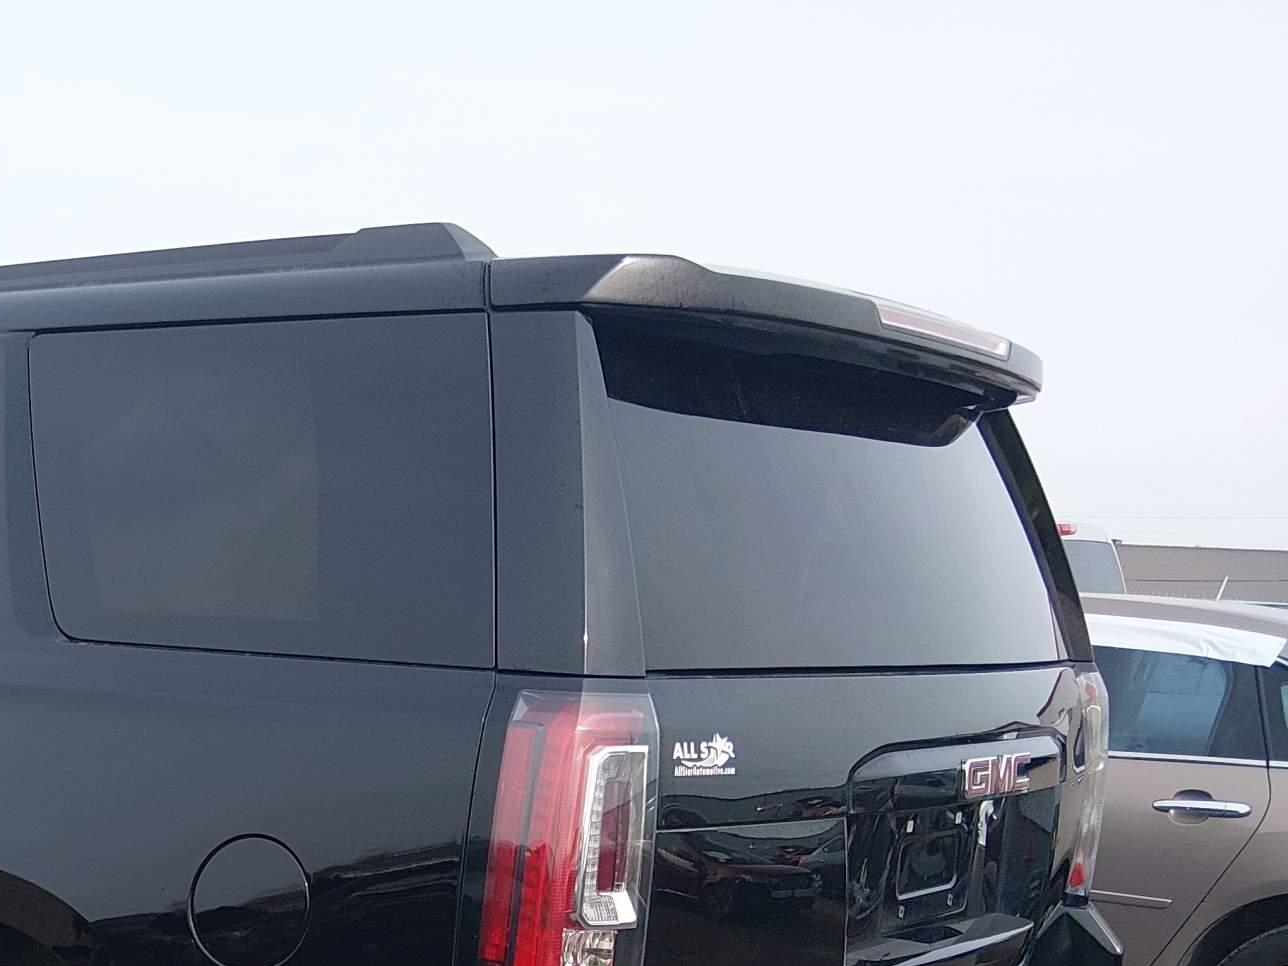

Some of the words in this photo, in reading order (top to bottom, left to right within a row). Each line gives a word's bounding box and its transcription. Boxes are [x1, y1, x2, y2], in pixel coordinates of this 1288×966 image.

[672, 741, 698, 760] ALL
[700, 740, 736, 760] STR
[964, 752, 1031, 797] GMC
